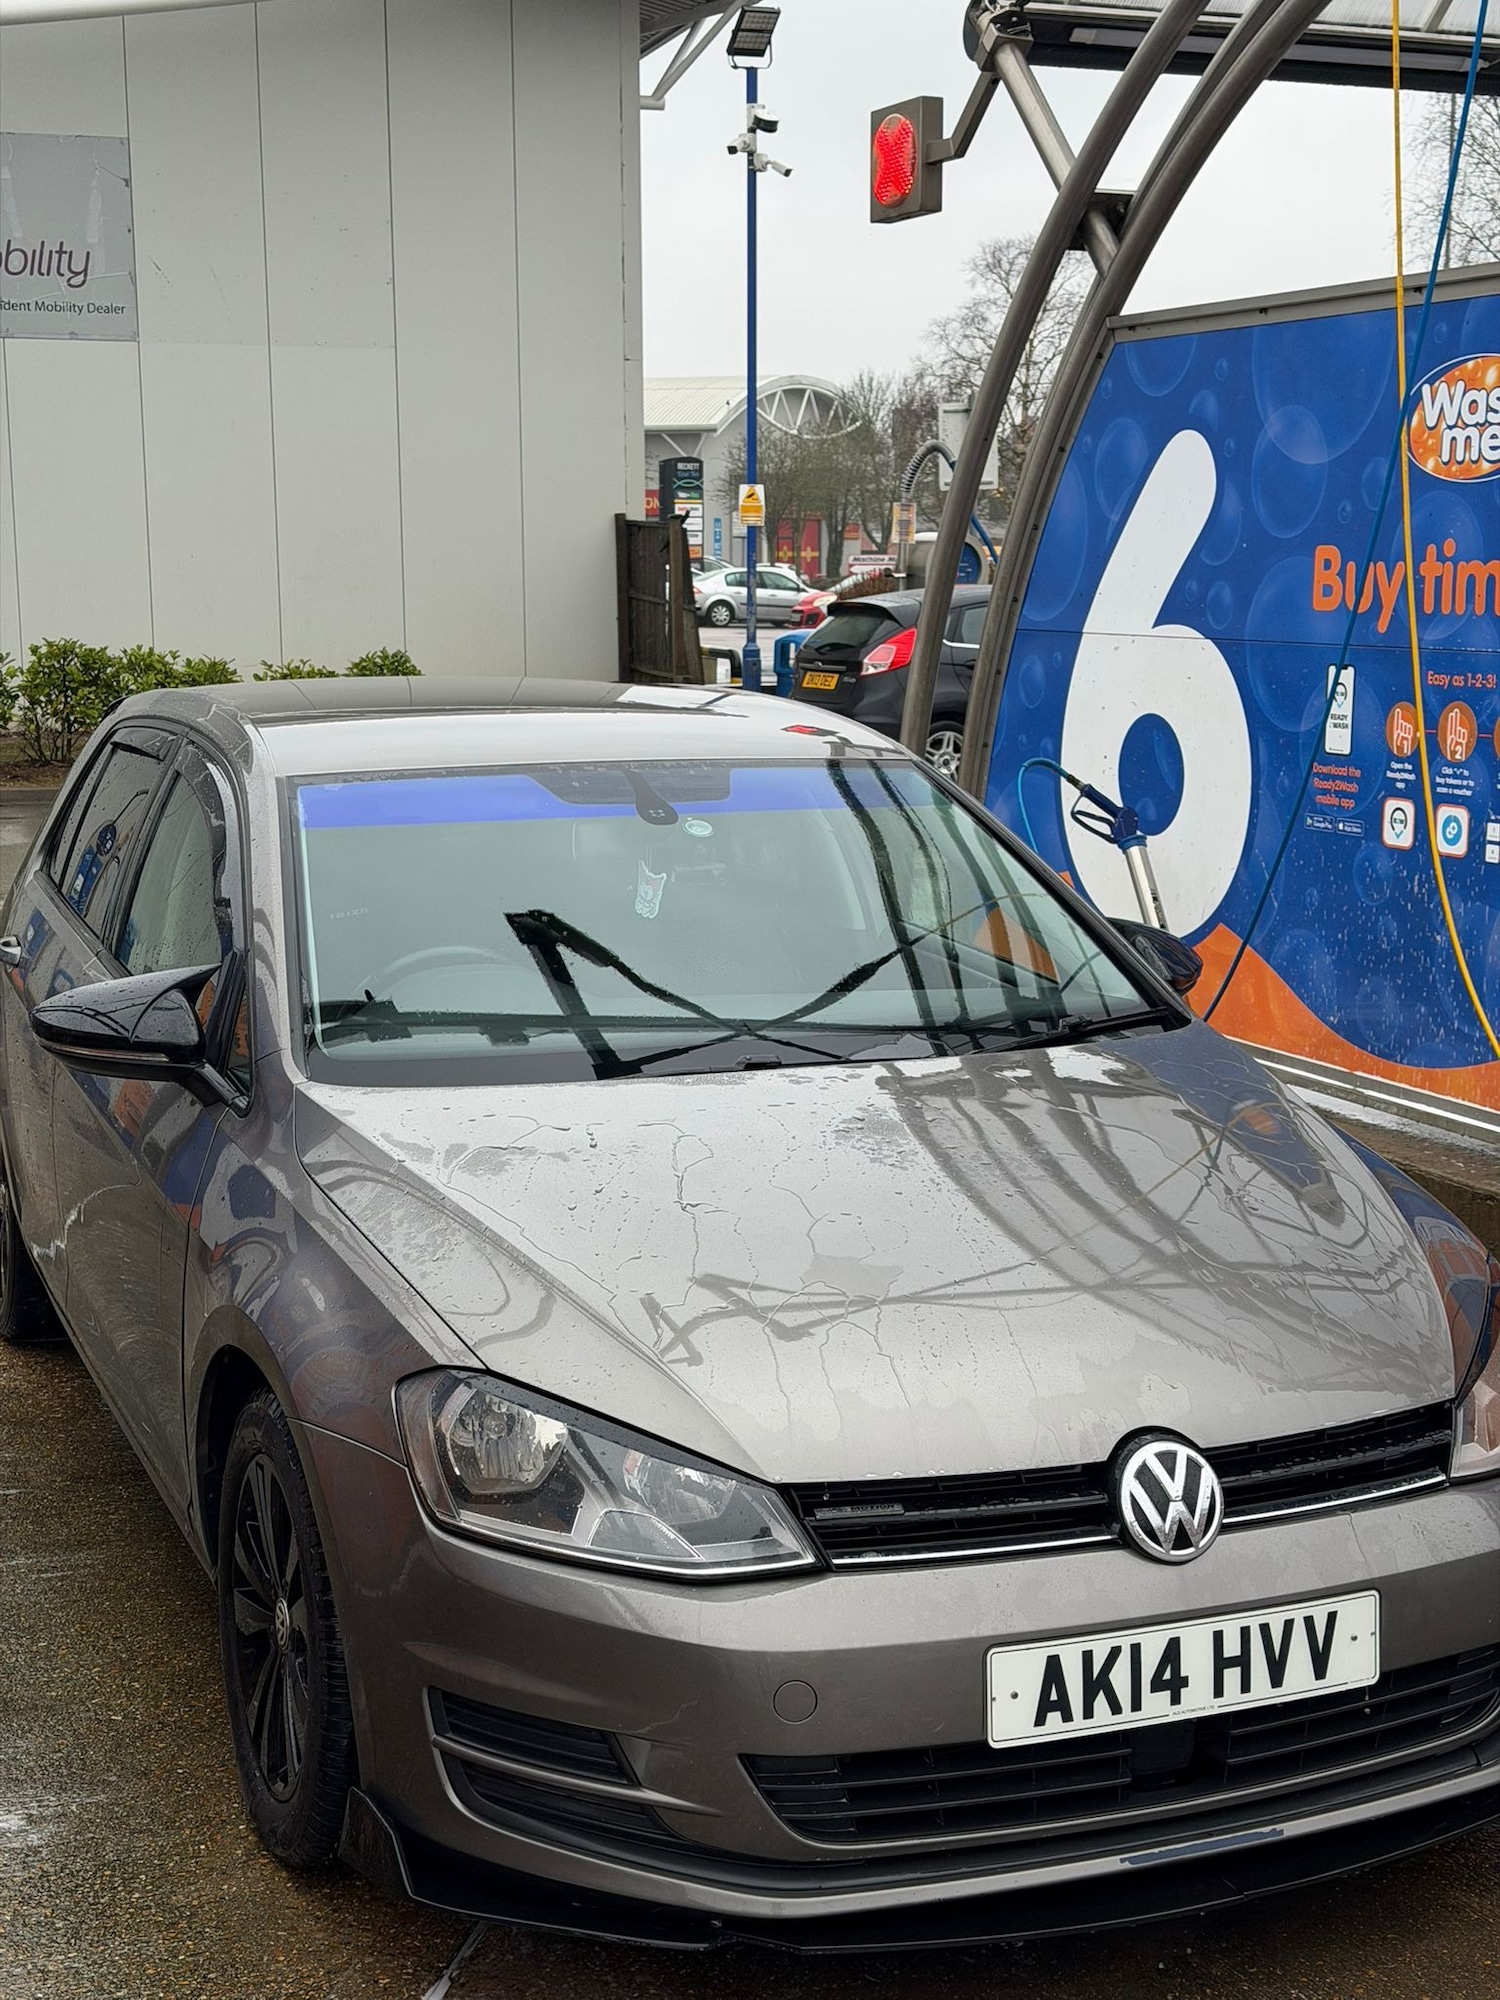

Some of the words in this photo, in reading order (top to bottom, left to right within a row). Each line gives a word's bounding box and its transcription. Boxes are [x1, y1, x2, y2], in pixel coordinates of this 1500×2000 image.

[0, 239, 91, 288] bility
[34, 301, 84, 316] Mobility
[87, 302, 126, 314] Dealer
[1441, 425, 1500, 463] me
[1312, 544, 1406, 634] Buy
[1061, 428, 1252, 938] 6
[1427, 671, 1450, 689] Easy
[1452, 675, 1465, 687] as
[1467, 673, 1496, 688] 1-2-3!
[1330, 713, 1348, 721] READY
[1403, 740, 1408, 754] 1
[1454, 745, 1462, 759] 2
[1313, 762, 1348, 776] Download
[1348, 766, 1361, 778] the
[1313, 778, 1359, 793] Ready2Wash
[1315, 793, 1340, 806] mobile
[1340, 798, 1356, 809] app
[1033, 1635, 1189, 1728] AK14
[1212, 1610, 1338, 1699] HVV
